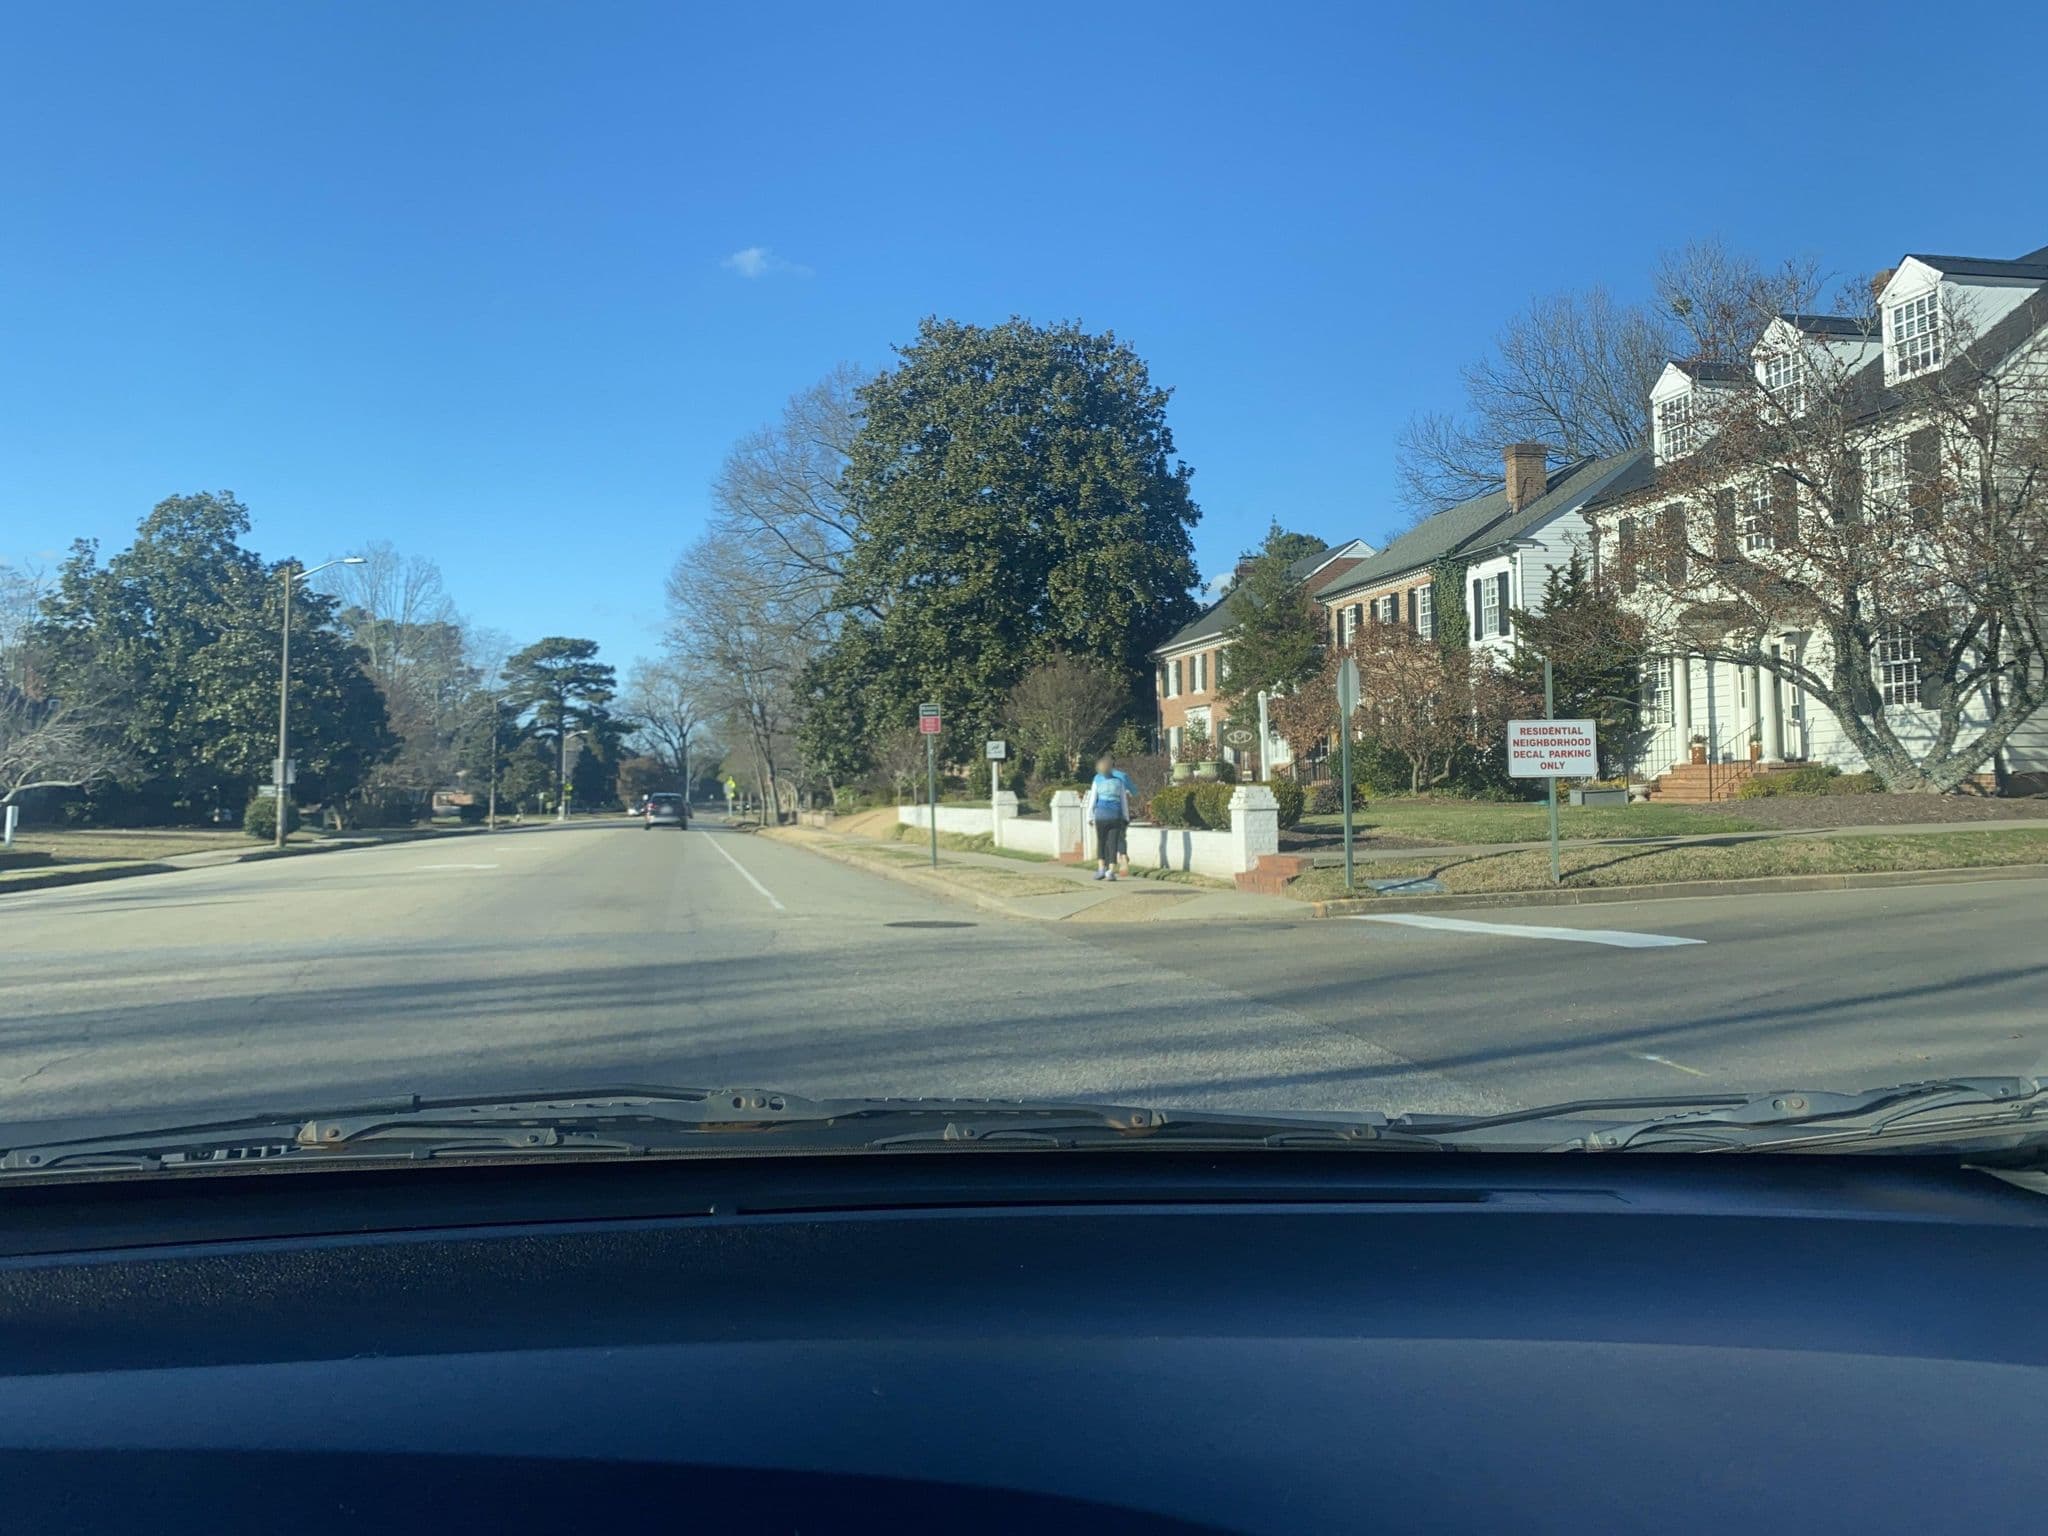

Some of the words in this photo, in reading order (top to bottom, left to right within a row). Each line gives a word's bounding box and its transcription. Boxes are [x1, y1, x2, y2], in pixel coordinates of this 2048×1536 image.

[1520, 727, 1583, 735] RESIDENTIAL
[1513, 738, 1591, 747] NEIGHBORHOOD
[1513, 750, 1545, 758] DECAL
[1549, 749, 1591, 758] PARKING
[1540, 761, 1566, 770] ONLY
